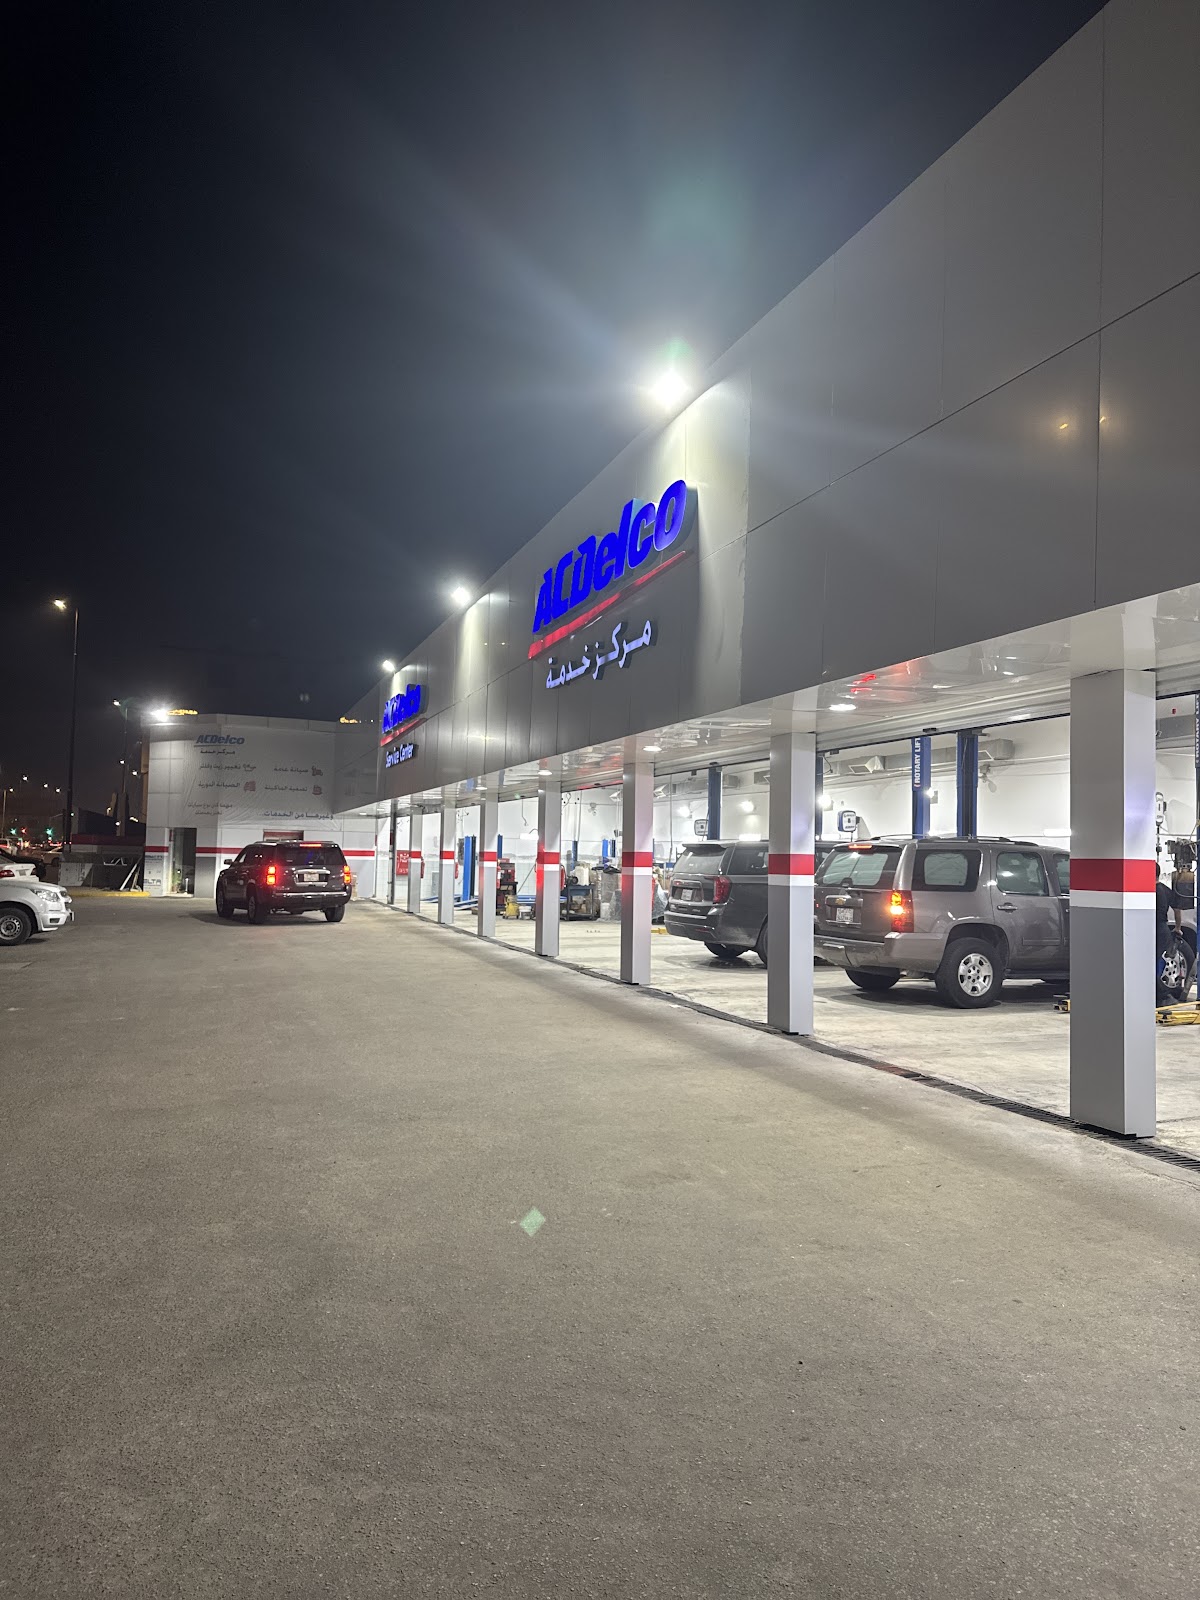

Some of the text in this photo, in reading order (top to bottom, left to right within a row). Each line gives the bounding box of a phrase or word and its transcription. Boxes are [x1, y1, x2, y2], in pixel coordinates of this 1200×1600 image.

[532, 479, 687, 633] ACDelco
[545, 619, 652, 689] مركز خدمة
[196, 735, 245, 745] ACDelco
[385, 743, 414, 768] Service Center
[216, 781, 240, 789] الصيانة
[295, 812, 304, 820] من
[306, 811, 334, 820] وغيرها
